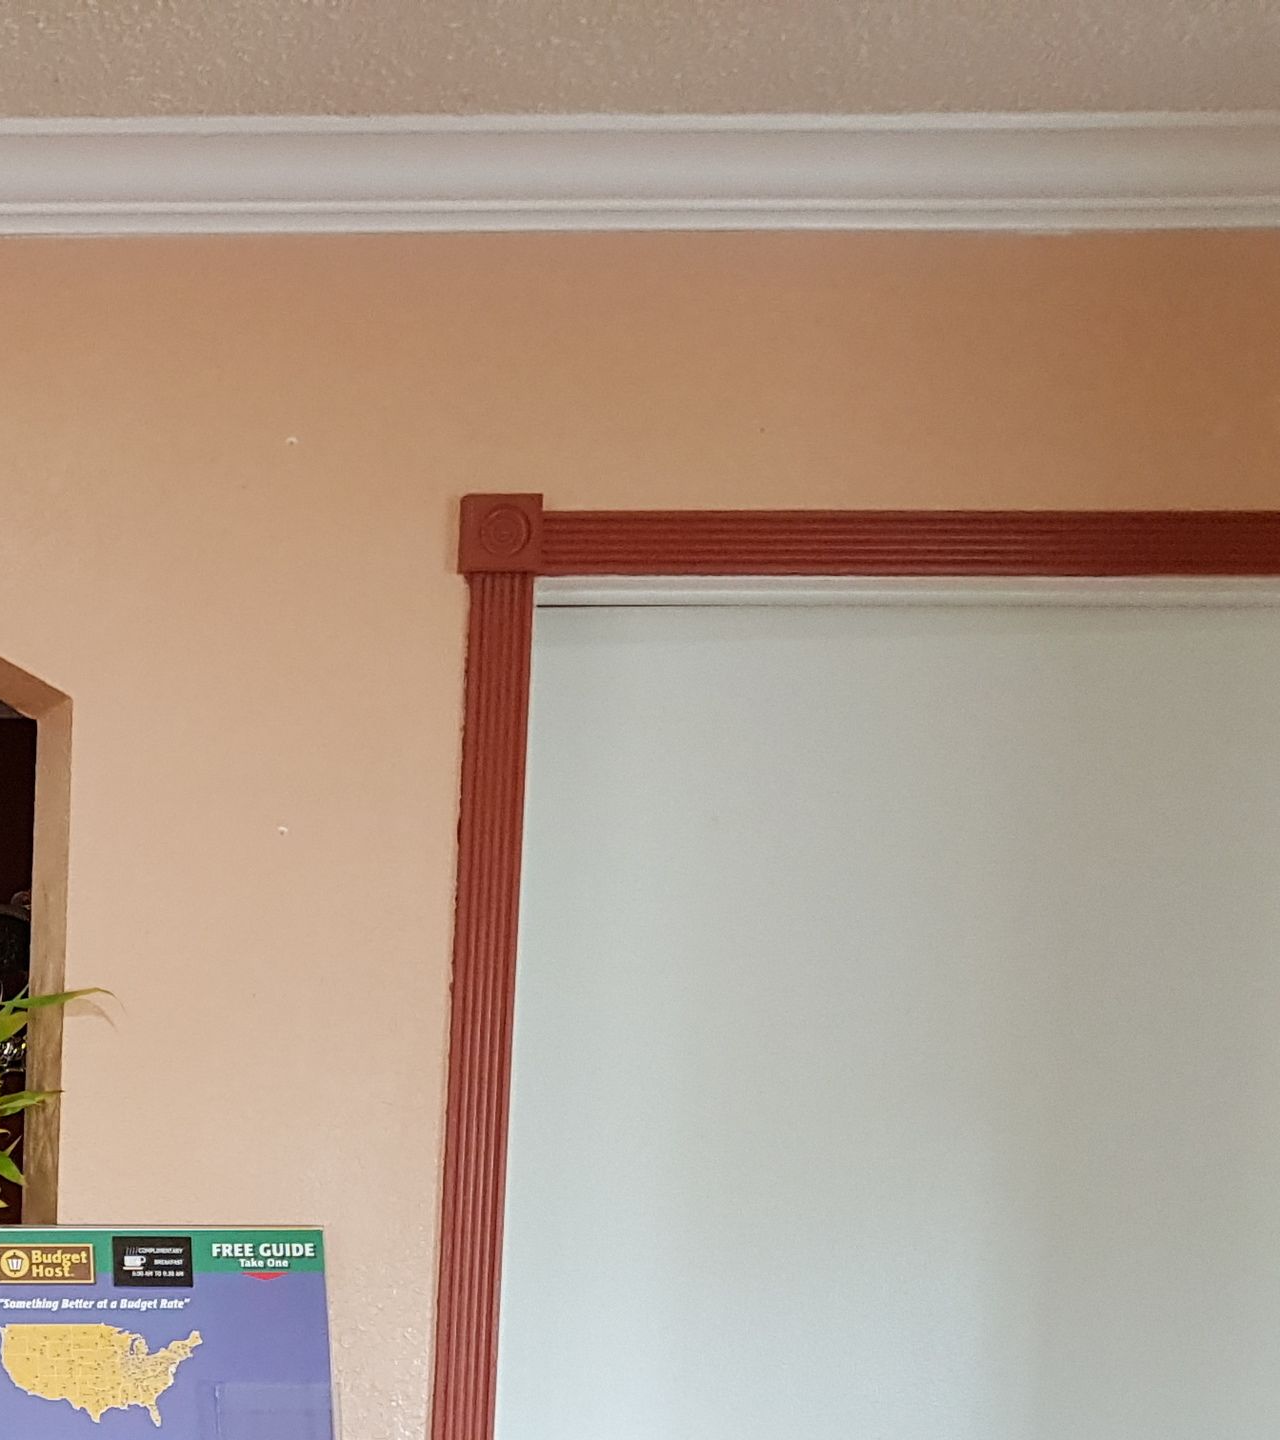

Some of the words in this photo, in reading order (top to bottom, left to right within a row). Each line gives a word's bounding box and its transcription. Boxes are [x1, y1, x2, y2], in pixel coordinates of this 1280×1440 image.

[211, 1243, 257, 1257] FREE
[258, 1242, 316, 1258] GUIDE
[31, 1250, 88, 1267] Budget
[239, 1258, 265, 1268] Take
[266, 1258, 289, 1268] One
[61, 1298, 95, 1309] Better
[96, 1299, 109, 1309] at
[109, 1301, 117, 1309] a
[119, 1298, 158, 1312] Budget
